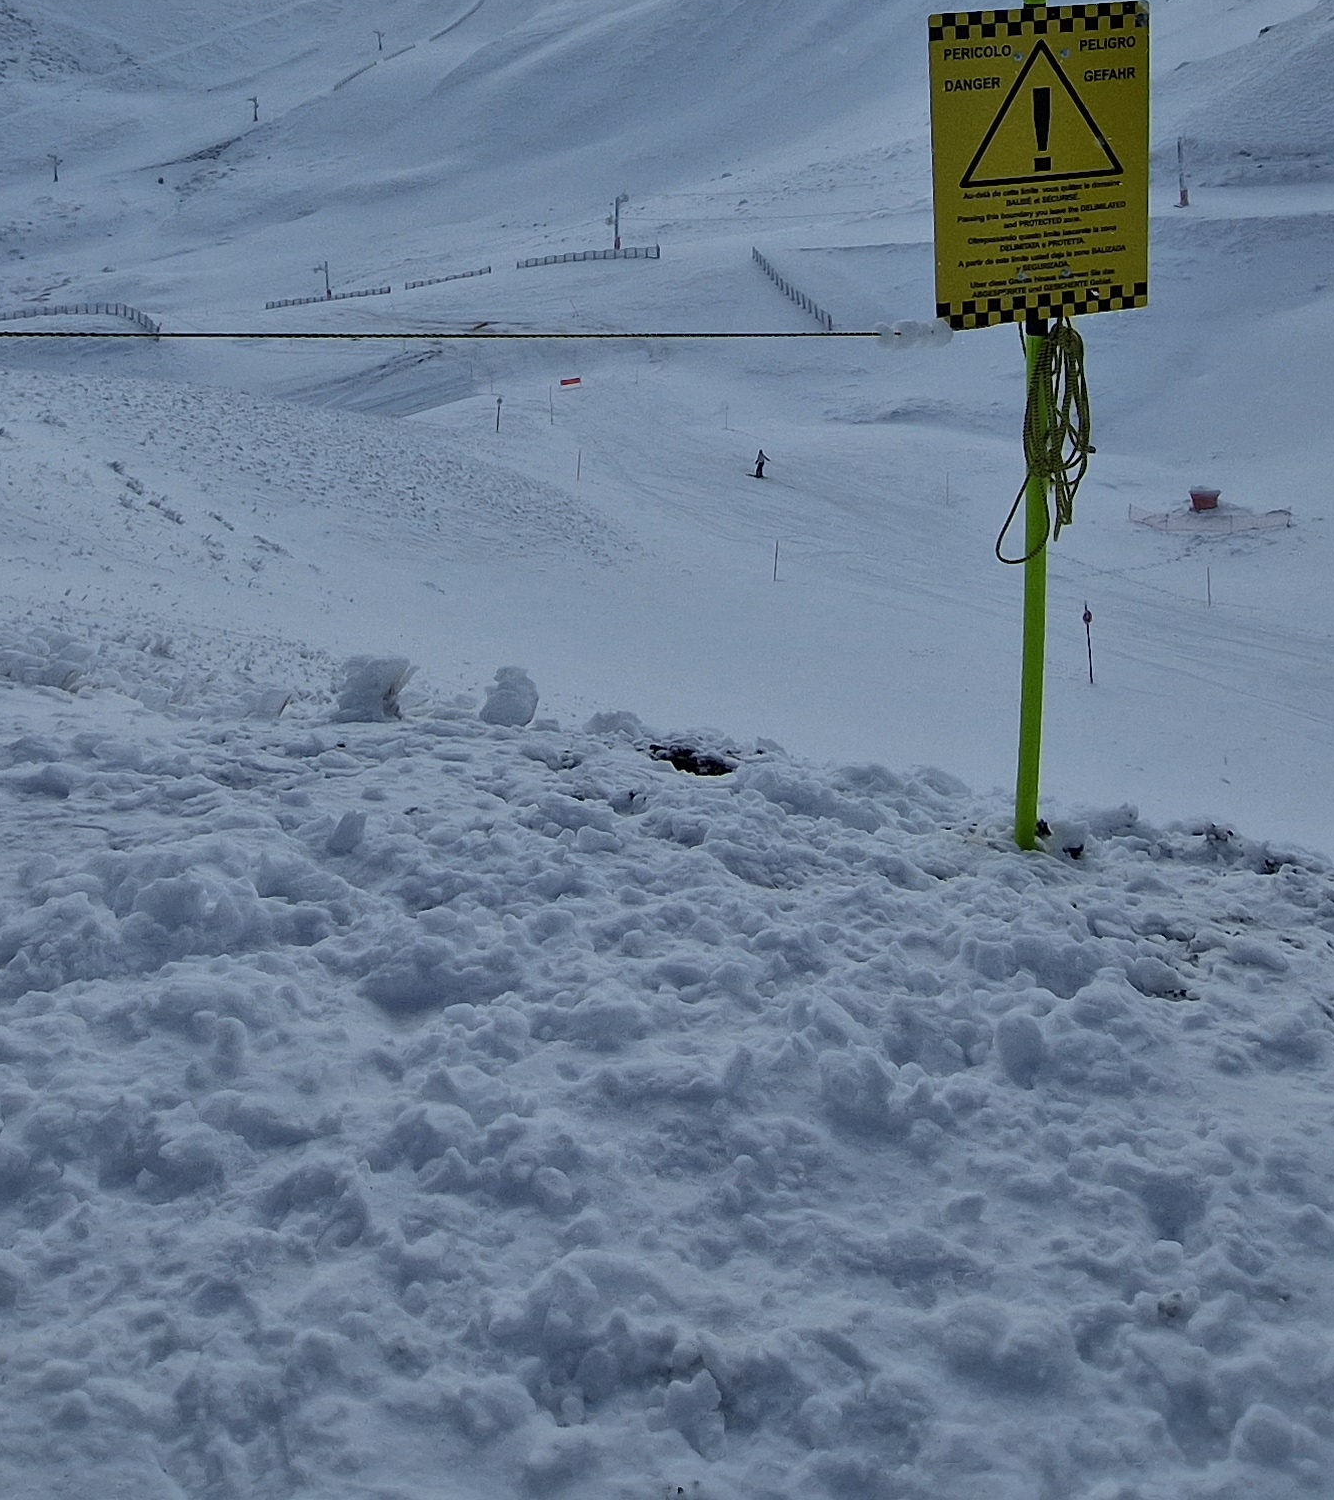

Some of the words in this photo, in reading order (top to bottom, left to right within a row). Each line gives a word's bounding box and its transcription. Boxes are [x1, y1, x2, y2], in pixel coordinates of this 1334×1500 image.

[1079, 35, 1136, 51] PELIGRO
[943, 45, 1012, 60] PERICOLO
[1084, 67, 1135, 82] GEFAHR
[945, 77, 1000, 92] DANGER
[1001, 210, 1033, 219] boundary
[1035, 210, 1048, 218] you
[1049, 207, 1067, 215] leave
[1068, 205, 1079, 213] the
[1004, 221, 1017, 229] and
[1019, 216, 1062, 227] PROTECTED
[958, 259, 965, 267] A
[1092, 245, 1126, 255] BALIZADA
